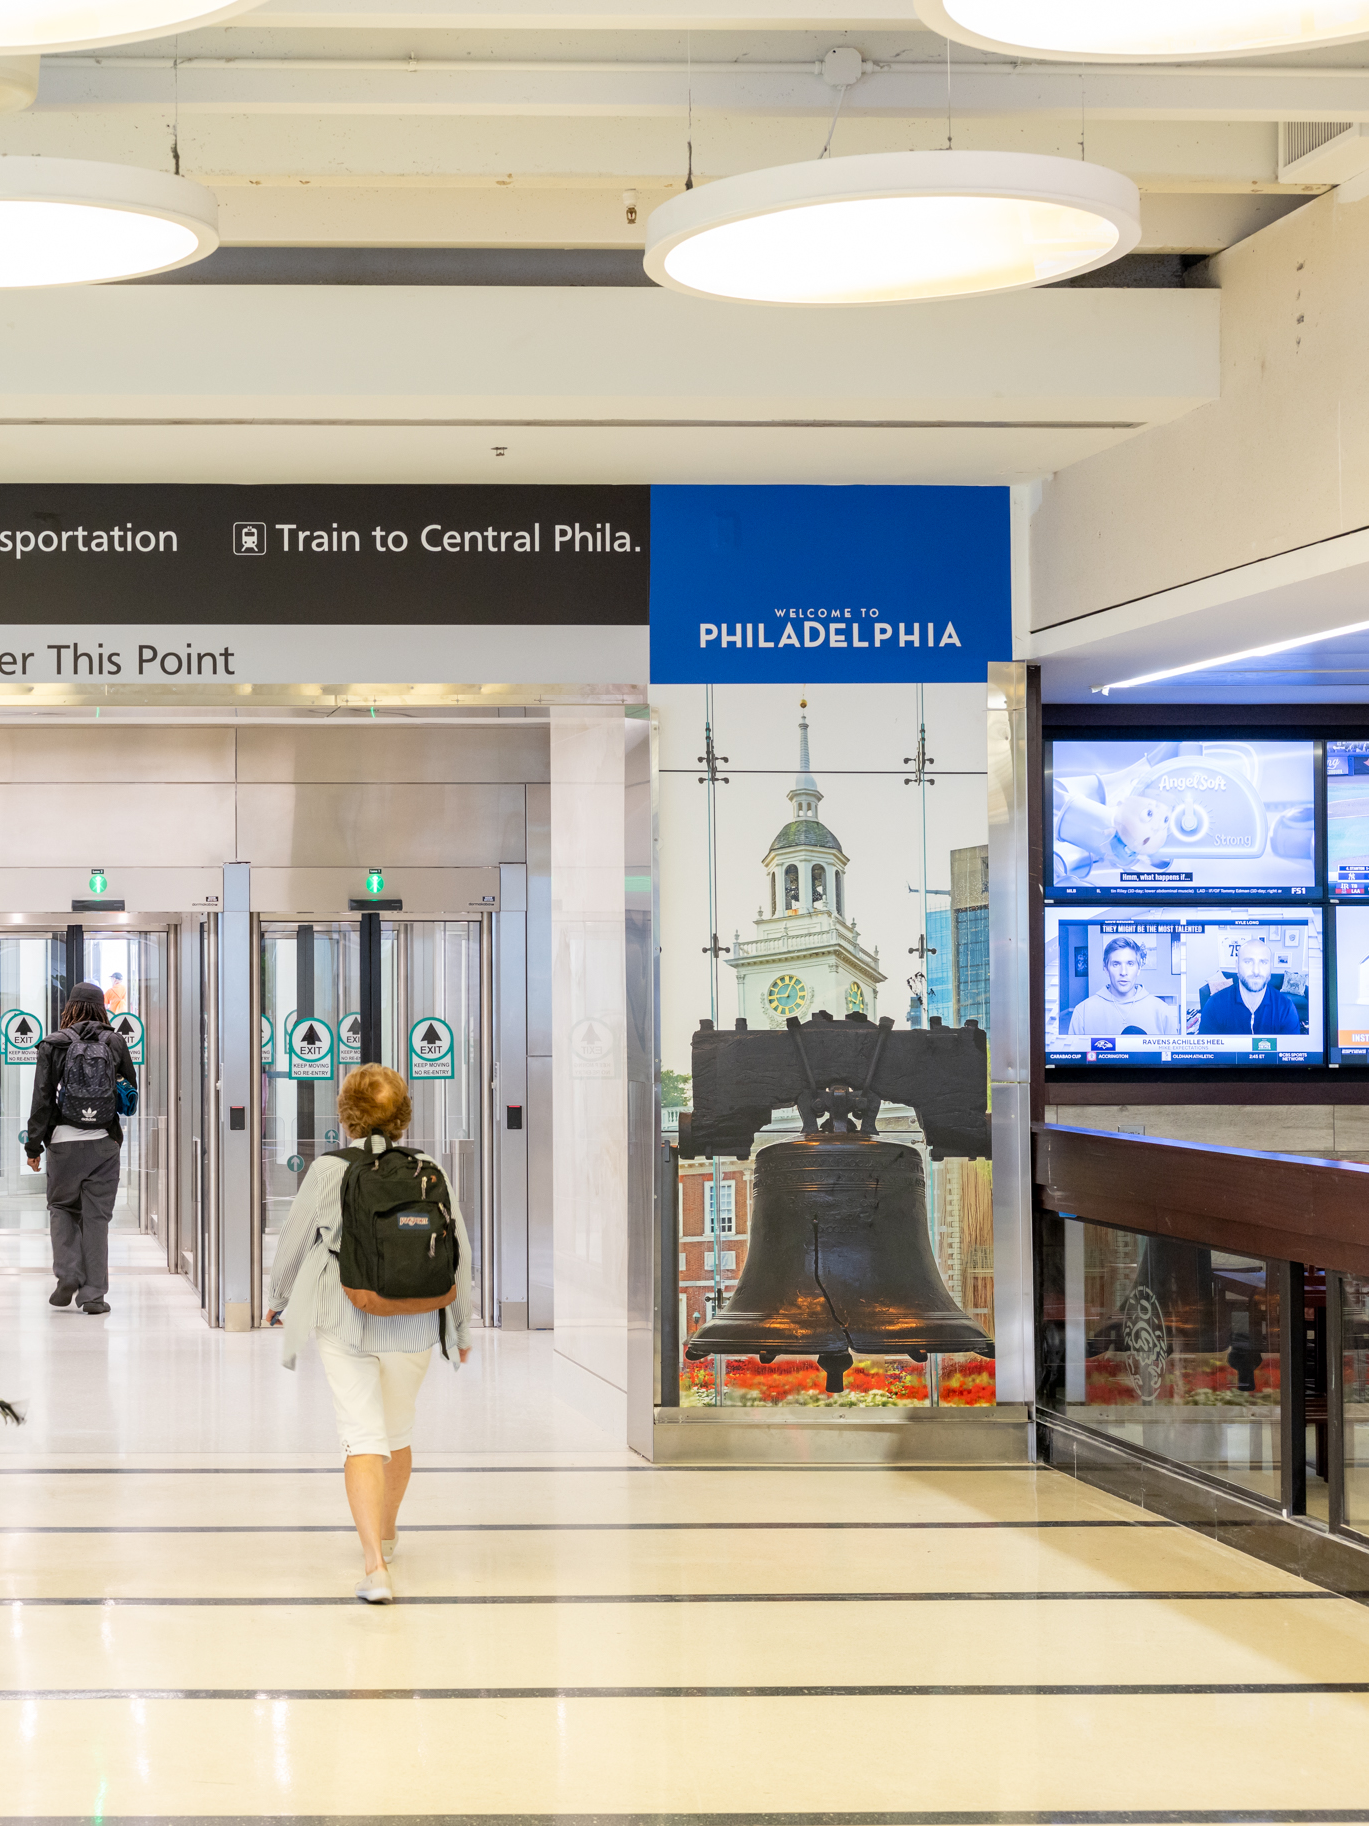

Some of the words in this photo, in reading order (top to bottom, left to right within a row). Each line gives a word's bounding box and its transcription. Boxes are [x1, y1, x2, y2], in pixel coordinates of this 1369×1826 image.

[275, 522, 361, 552] Train
[371, 525, 408, 552] to
[420, 522, 541, 553] Central
[554, 522, 642, 553] Phila.
[774, 608, 852, 618] WELCOME
[860, 608, 880, 618] TO
[699, 620, 962, 649] PHILADELPHIA
[46, 642, 122, 676] This
[138, 642, 235, 676] Point
[1214, 833, 1252, 847] Strong
[1122, 873, 1139, 881] Hmm,
[1140, 873, 1154, 881] what
[1155, 873, 1180, 882] happens
[1102, 925, 1118, 933] THEY
[1117, 925, 1136, 933] MIGHT
[1137, 925, 1145, 933] BE
[1146, 925, 1157, 933] THE
[1157, 925, 1174, 933] MOST
[1174, 925, 1203, 933] TALENTED
[14, 1036, 34, 1044] EXIT
[124, 1036, 135, 1044] XIT
[300, 1046, 323, 1055] EXIT
[420, 1045, 443, 1055] EXIT
